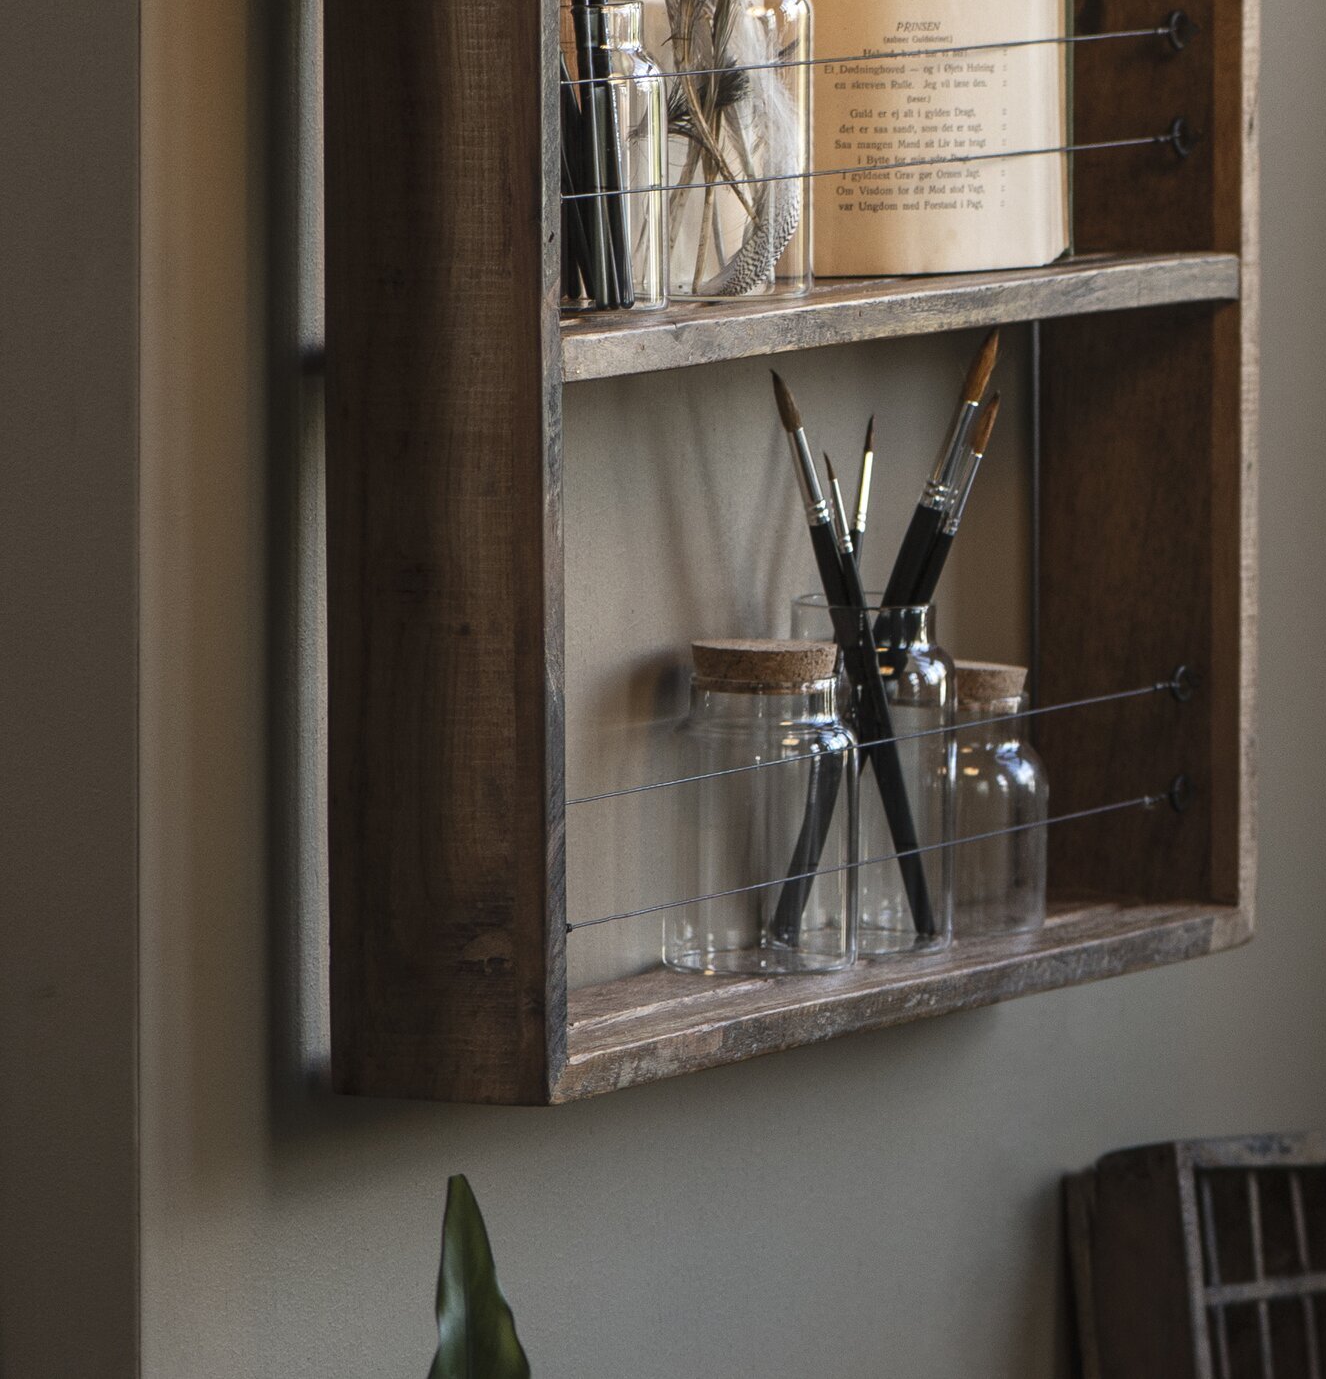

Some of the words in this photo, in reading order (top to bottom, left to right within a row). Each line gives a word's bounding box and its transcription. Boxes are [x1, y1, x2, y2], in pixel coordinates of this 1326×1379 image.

[895, 21, 942, 32] PRINSEN
[840, 65, 905, 75] Dødninghoved
[923, 66, 934, 75] og
[851, 81, 887, 89] skreven
[923, 80, 938, 90] Jeg
[850, 109, 874, 118] Guld
[891, 109, 900, 120] ej
[839, 124, 855, 133] det
[835, 140, 852, 149] Saa
[857, 142, 893, 151] mangen
[897, 140, 921, 148] Mand
[836, 186, 854, 195] Om
[859, 186, 894, 195] Visdom
[897, 186, 910, 195] for
[928, 185, 946, 194] Mod
[839, 203, 854, 211] var
[858, 201, 898, 213] Ungdom
[902, 202, 920, 210] med
